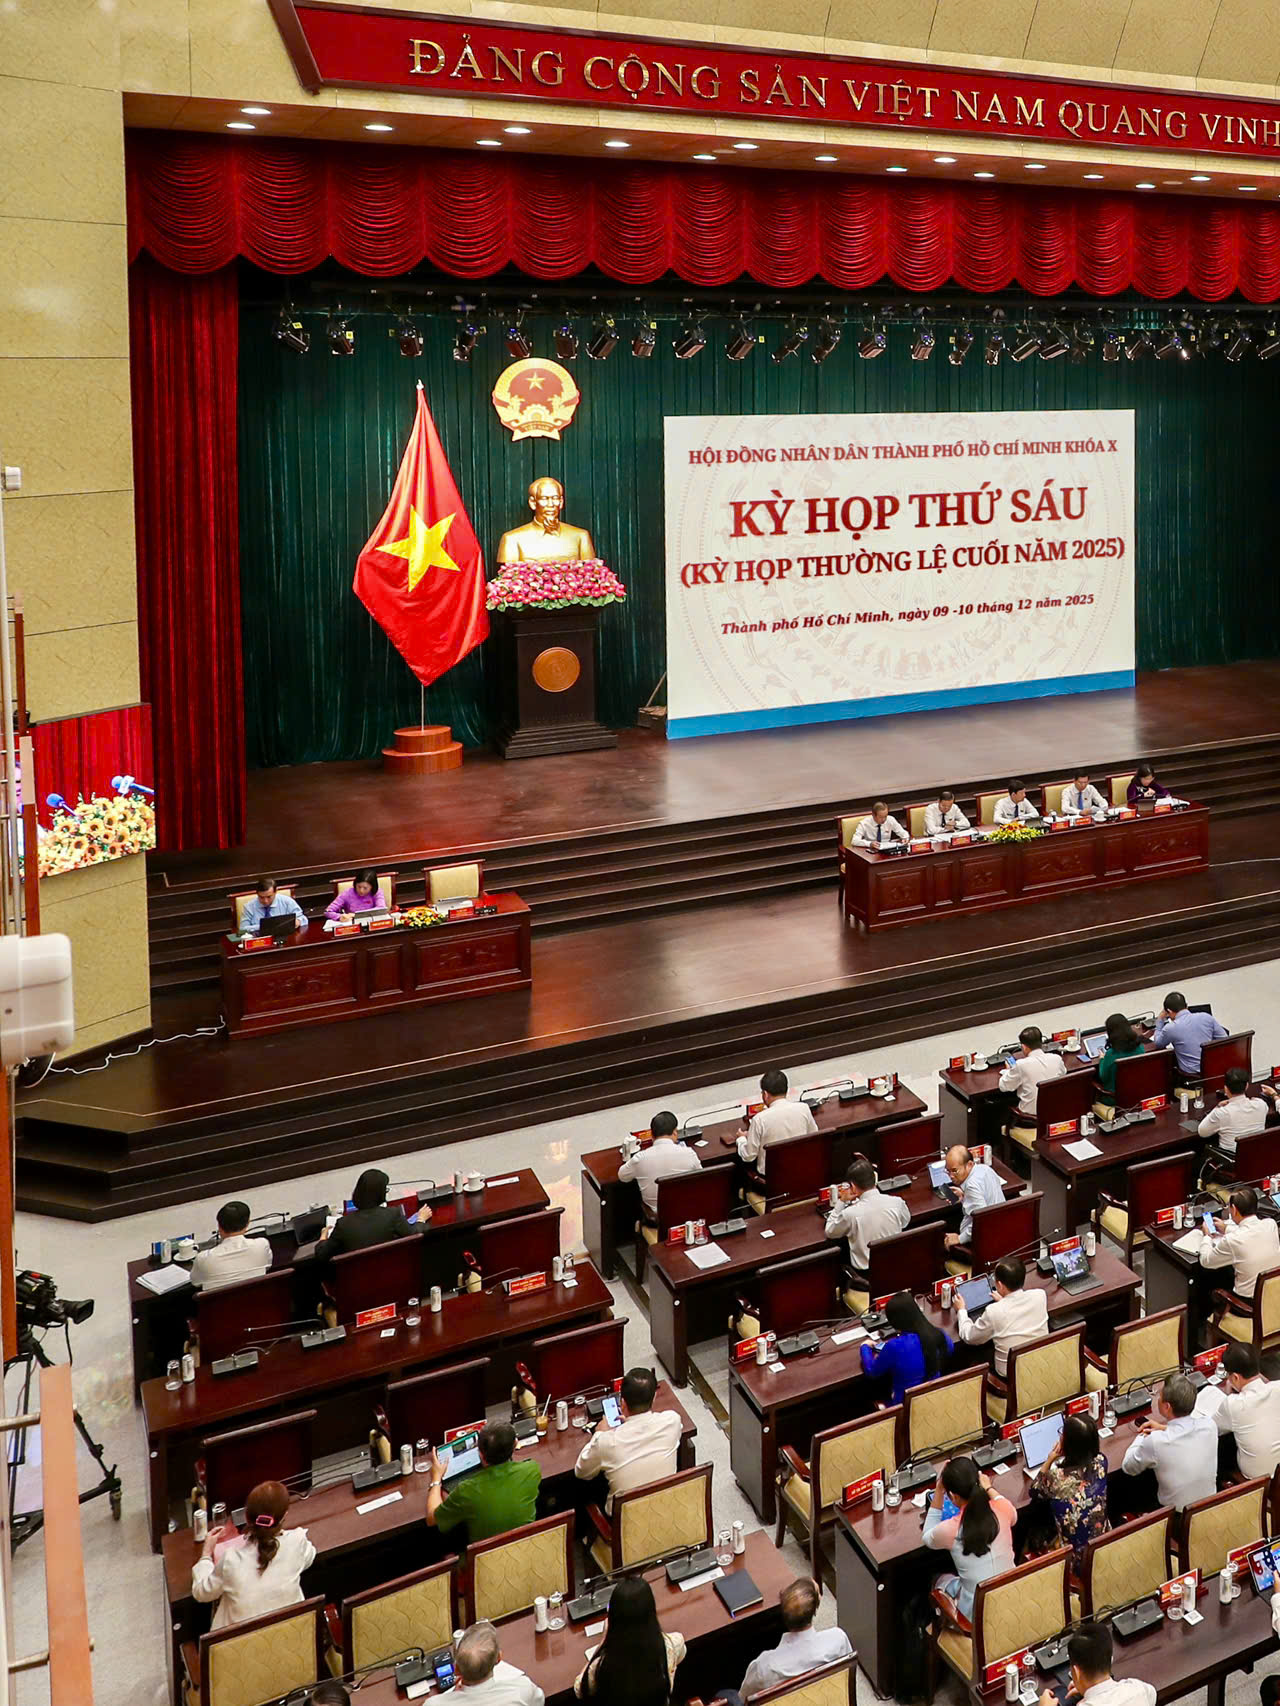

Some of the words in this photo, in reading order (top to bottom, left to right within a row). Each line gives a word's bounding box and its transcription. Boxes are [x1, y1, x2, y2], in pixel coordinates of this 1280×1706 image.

[409, 33, 563, 86] ĐẢNG
[584, 53, 720, 99] CỘNG
[740, 63, 827, 109] SẢN
[843, 79, 939, 121] VIỆT
[952, 90, 1045, 128] NAM
[1057, 99, 1188, 139] QUANG
[689, 447, 721, 467] HỘI
[726, 445, 777, 463] ĐỒNG
[780, 444, 830, 461] NHÂN
[834, 443, 869, 460] DÂN
[872, 442, 929, 460] THÀNH
[933, 440, 964, 457] PHỐ
[968, 440, 990, 456] HỒ
[994, 439, 1019, 455] CHÍ
[1022, 441, 1061, 455] MINH
[1065, 437, 1105, 453] KHÓA
[1107, 440, 1118, 452] X
[729, 489, 795, 538] KỲ
[804, 495, 900, 541] HỌP
[908, 481, 1003, 528] THỨ
[1010, 479, 1088, 523] SÁU
[680, 556, 729, 588] (KỲ
[734, 559, 792, 586] HỌP
[797, 548, 912, 578] THƯỜNG
[917, 544, 947, 574] LỆ
[953, 539, 1009, 567] CUỐI
[1014, 538, 1068, 563] NĂM
[1072, 537, 1125, 560] 2025)
[721, 620, 767, 634] Thành
[772, 616, 799, 633] phố
[827, 613, 851, 626] Chí
[854, 610, 894, 624] Minh,
[898, 608, 930, 622] ngày
[933, 606, 949, 617] 09
[953, 604, 973, 615] -10
[977, 602, 1013, 613] tháng
[1017, 599, 1032, 610] 12
[1035, 597, 1061, 608] năm
[1065, 594, 1094, 606] 2025
